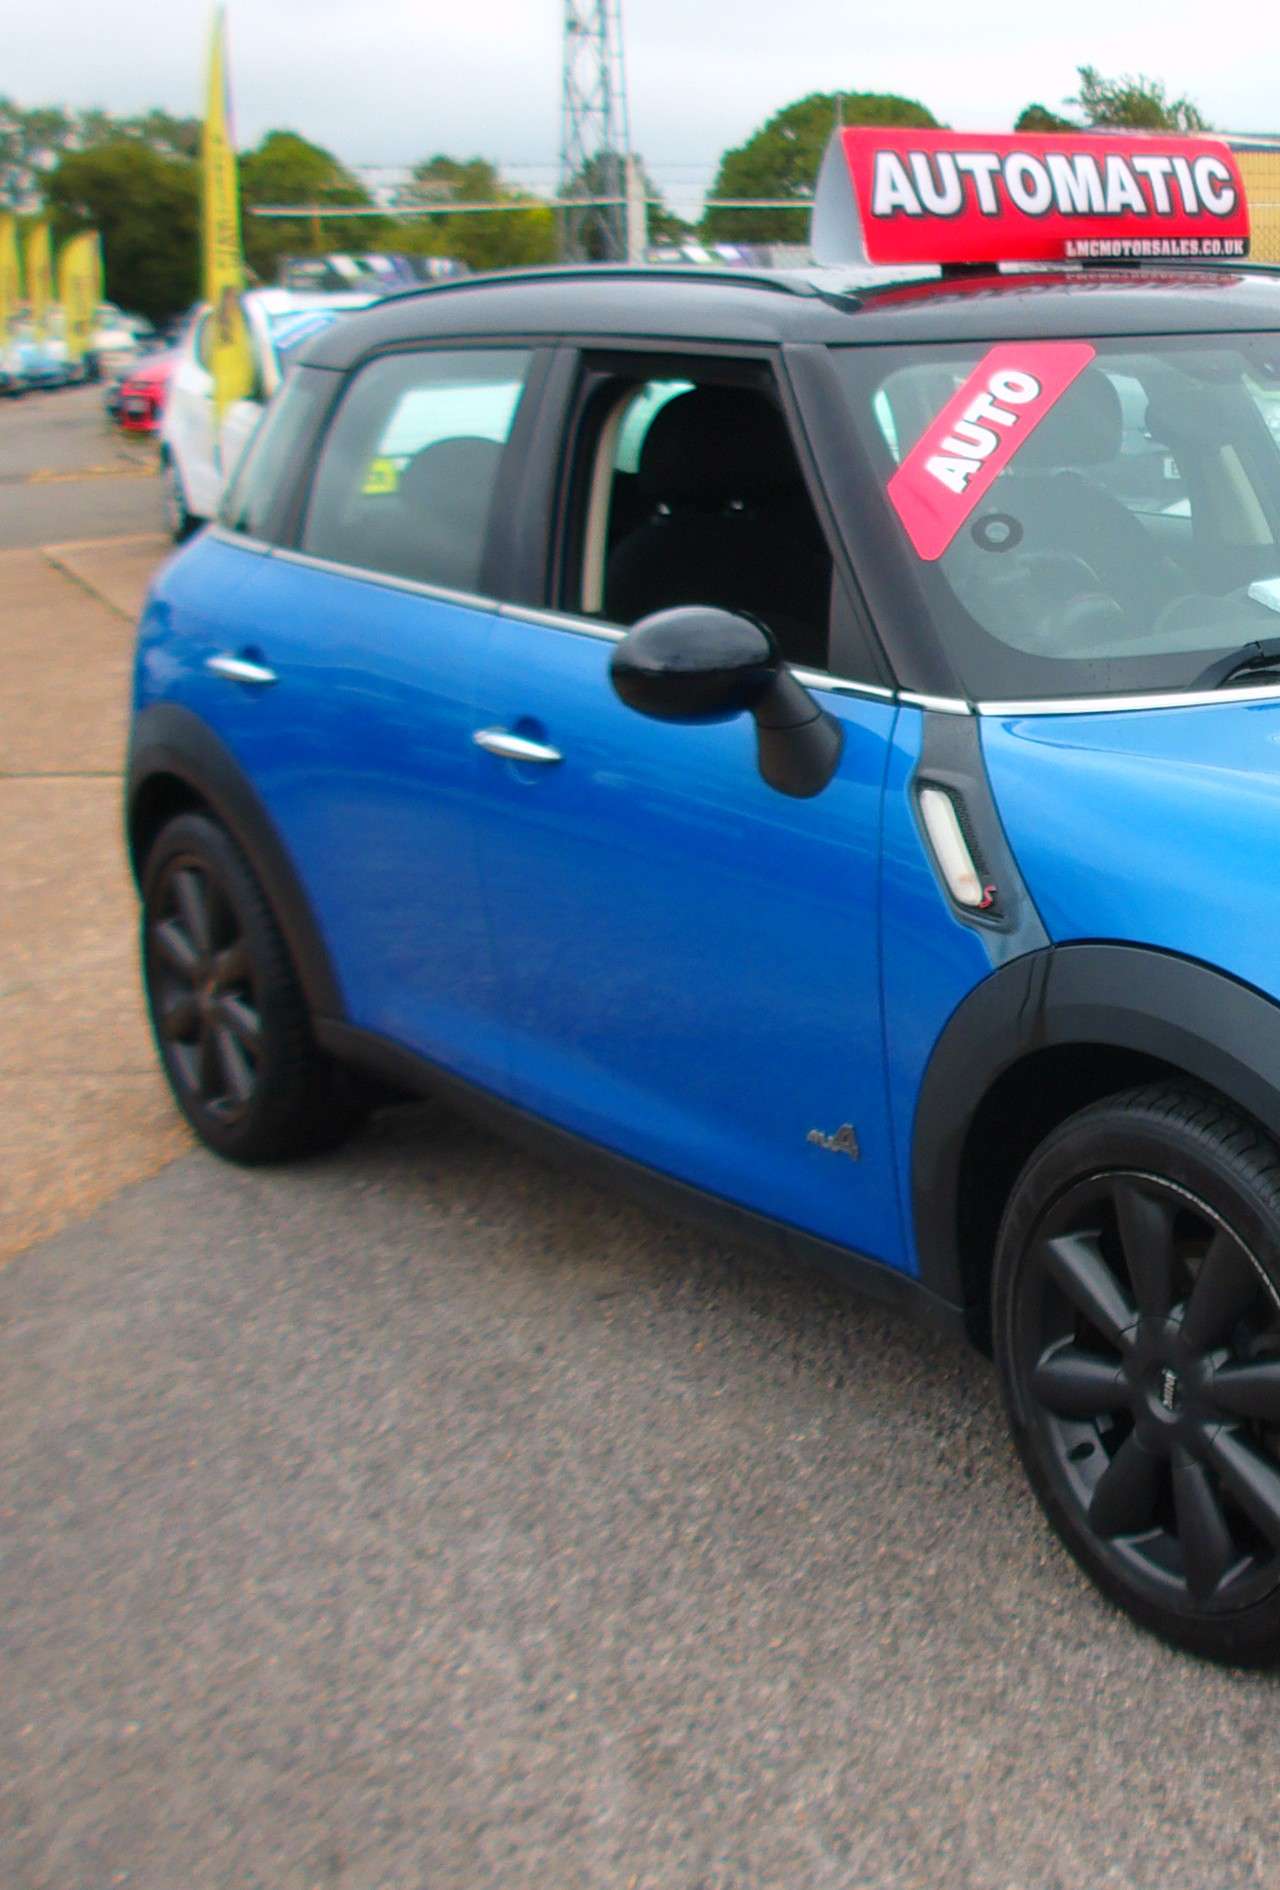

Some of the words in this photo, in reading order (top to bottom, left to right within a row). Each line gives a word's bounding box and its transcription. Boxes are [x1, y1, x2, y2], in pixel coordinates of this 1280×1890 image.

[873, 151, 1236, 217] AUTOMATIC
[1065, 237, 1245, 258] LMCMOTORSALES.CO.UK
[924, 369, 1041, 494] AUTO
